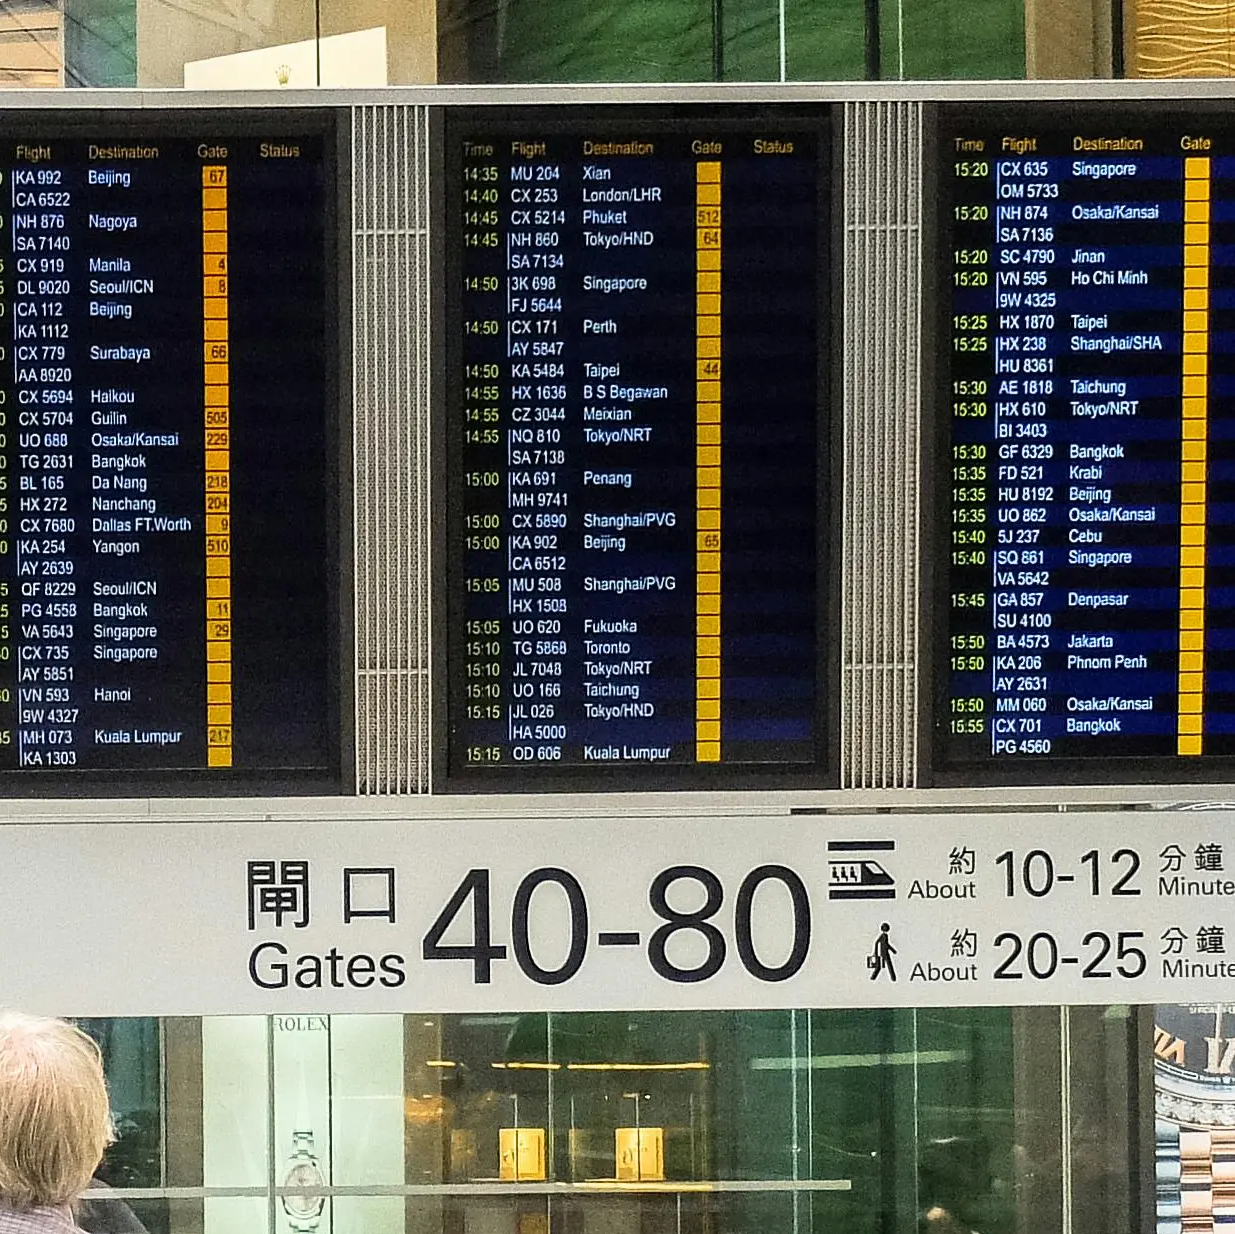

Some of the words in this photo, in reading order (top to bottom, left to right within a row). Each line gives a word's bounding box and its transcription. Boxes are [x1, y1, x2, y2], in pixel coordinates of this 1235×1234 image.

[88, 145, 159, 160] Destination
[197, 143, 228, 158] Gate
[511, 141, 546, 159] Flight
[583, 140, 654, 155] Destination
[955, 137, 984, 152] Time
[1002, 136, 1037, 155] Flight
[1073, 136, 1143, 151] Destination
[1180, 135, 1211, 150] Gate
[15, 170, 36, 185] KA
[37, 170, 62, 185] 992
[88, 169, 131, 188] Beijing
[955, 162, 989, 177] 15:20
[1000, 161, 1021, 177] CX
[1023, 161, 1049, 177] 635
[1072, 161, 1137, 180] Singapore
[465, 188, 499, 204] 14:40
[510, 188, 531, 203] CX
[534, 188, 558, 203] 253
[582, 187, 662, 202] London/LHR
[89, 214, 138, 232] Nagoya
[583, 209, 627, 224] Phuket
[583, 230, 654, 249] Tokyo/HND
[1071, 248, 1106, 264] Jinan
[17, 258, 37, 273] CX
[40, 258, 65, 273] 919
[1071, 270, 1090, 285] Ho
[1092, 270, 1115, 285] Chi
[1117, 270, 1148, 285] Minh
[511, 319, 532, 335] CX
[536, 319, 557, 334] 171
[583, 319, 617, 334] Perth
[90, 345, 151, 363] Surabaya
[583, 406, 632, 421] Meixian
[466, 471, 500, 487] 15:00
[512, 471, 531, 486] KA
[533, 471, 556, 486] 691
[583, 470, 632, 488] Penang
[953, 466, 987, 481] 15:35
[998, 465, 1018, 480] FD
[1020, 465, 1043, 480] 521
[1069, 465, 1103, 480] Krabi
[20, 497, 41, 512] HX
[43, 497, 67, 512] 272
[92, 496, 156, 514] Nanchang
[92, 517, 132, 532] Dallas
[135, 517, 192, 532] FT.Worth
[997, 529, 1013, 544] 5J
[1015, 529, 1040, 544] 237
[1068, 528, 1103, 543] Cebu
[1068, 591, 1129, 609] Denpasar
[1067, 634, 1114, 648] Jakarta
[94, 687, 131, 702] Hanoi
[583, 682, 640, 700] Taichung
[23, 751, 43, 766] KA
[46, 751, 77, 765] 1303
[949, 847, 975, 874] 約
[1159, 843, 1224, 872] 分鐘
[908, 880, 976, 898] About
[996, 849, 1141, 897] 10-12
[248, 861, 395, 930] 閘口
[249, 943, 405, 989] Gates
[423, 865, 811, 985] 40-80
[951, 928, 976, 957] 約
[1161, 926, 1225, 954] 分鐘
[910, 963, 977, 981] About
[994, 932, 1146, 979] 20-25
